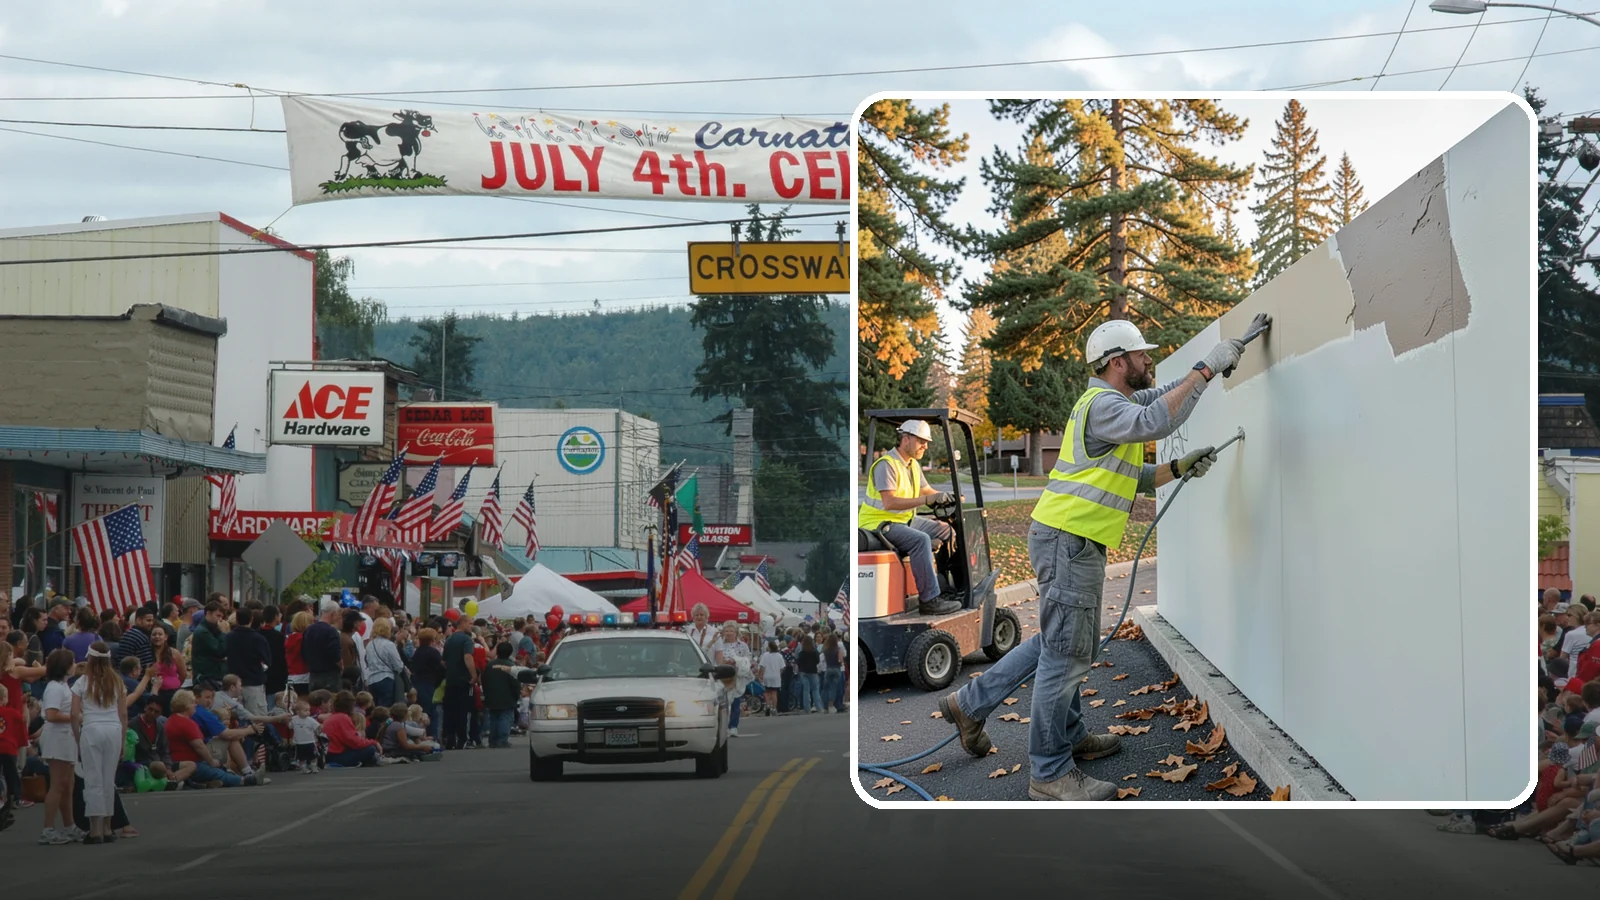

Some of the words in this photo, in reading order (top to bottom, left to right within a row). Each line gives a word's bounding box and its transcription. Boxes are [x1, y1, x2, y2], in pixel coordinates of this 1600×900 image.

[481, 140, 605, 193] JULY
[632, 150, 746, 198] 4th.
[697, 253, 850, 281] CROSSWA
[283, 380, 373, 420] ACE
[405, 408, 452, 422] CEDAR
[461, 409, 485, 422] LOG
[283, 421, 371, 437] Hardware
[83, 484, 94, 495] St.
[96, 485, 124, 495] Vincent
[126, 486, 136, 495] de
[137, 486, 155, 496] Paul
[688, 526, 741, 535] CRNATION
[699, 535, 730, 544] GLASS
